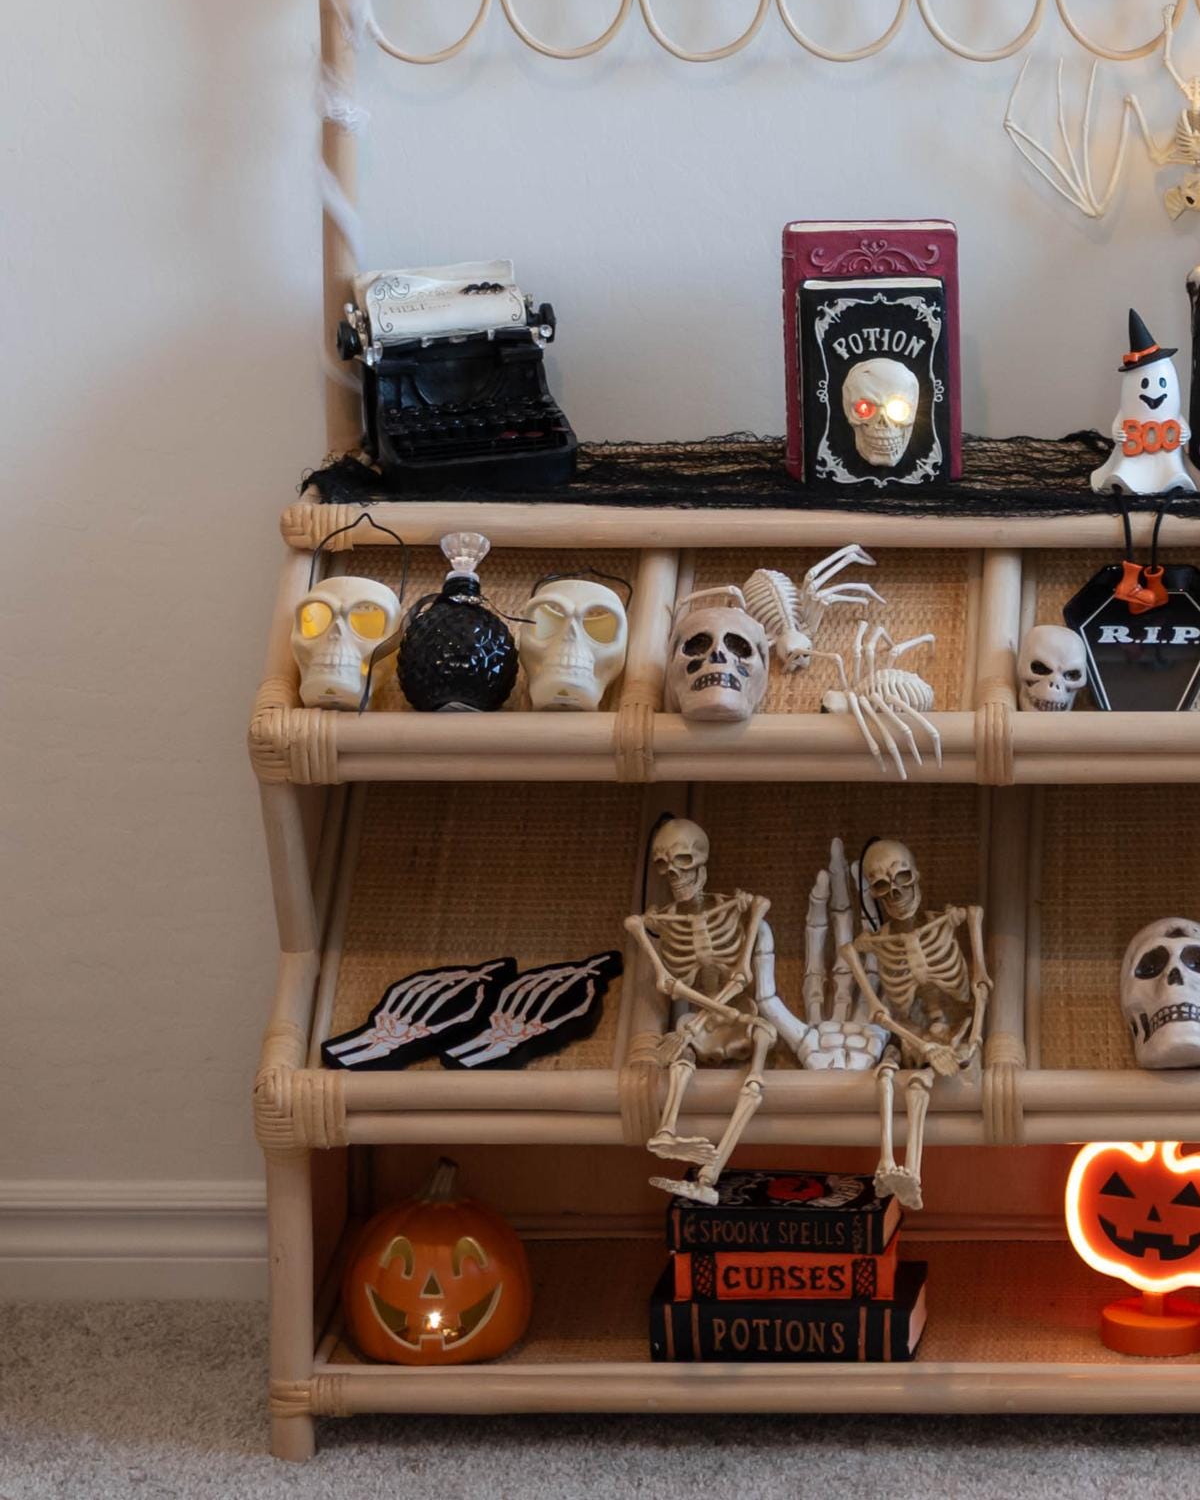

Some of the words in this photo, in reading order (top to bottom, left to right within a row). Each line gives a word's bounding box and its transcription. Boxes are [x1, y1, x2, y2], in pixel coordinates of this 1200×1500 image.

[833, 328, 926, 360] POTION
[1122, 419, 1181, 457] BOO
[1097, 625, 1200, 644] R.I.P.
[699, 1219, 770, 1244] SPOOKY
[778, 1221, 846, 1246] SPELLS
[722, 1265, 846, 1292] CURSES
[712, 1318, 846, 1354] POTIONS
